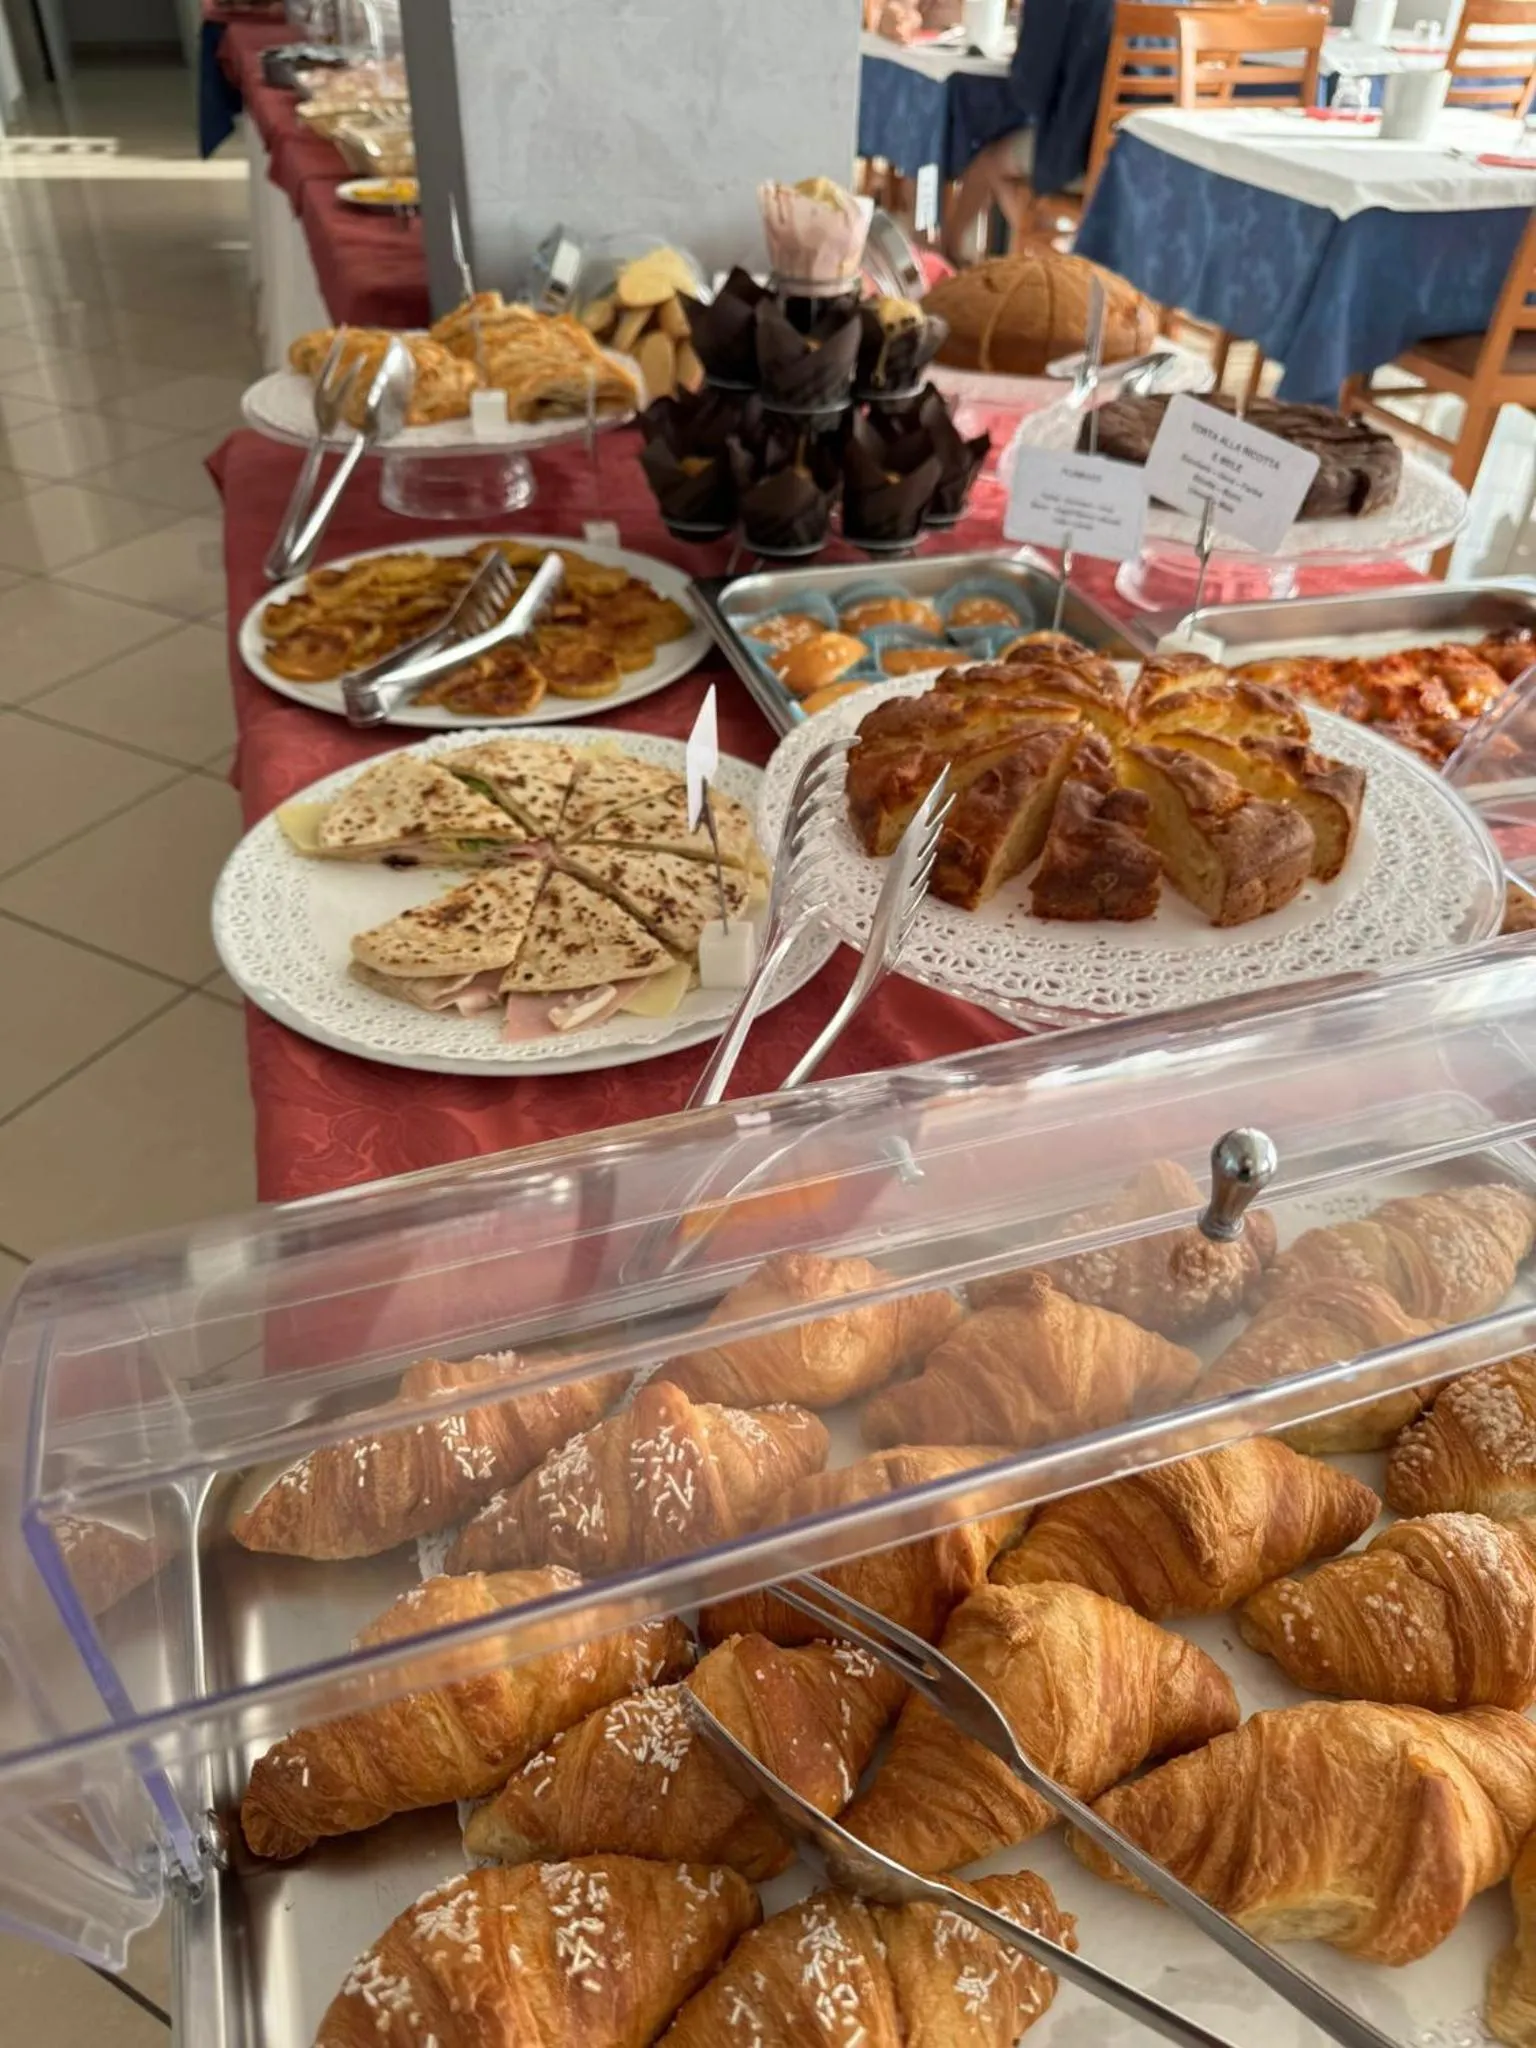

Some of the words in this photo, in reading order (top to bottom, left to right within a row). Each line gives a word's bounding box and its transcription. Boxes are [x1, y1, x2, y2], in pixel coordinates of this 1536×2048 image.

[1191, 421, 1218, 441] TORTA
[1220, 436, 1241, 452] ALLA
[1243, 446, 1280, 470] RICOTTA
